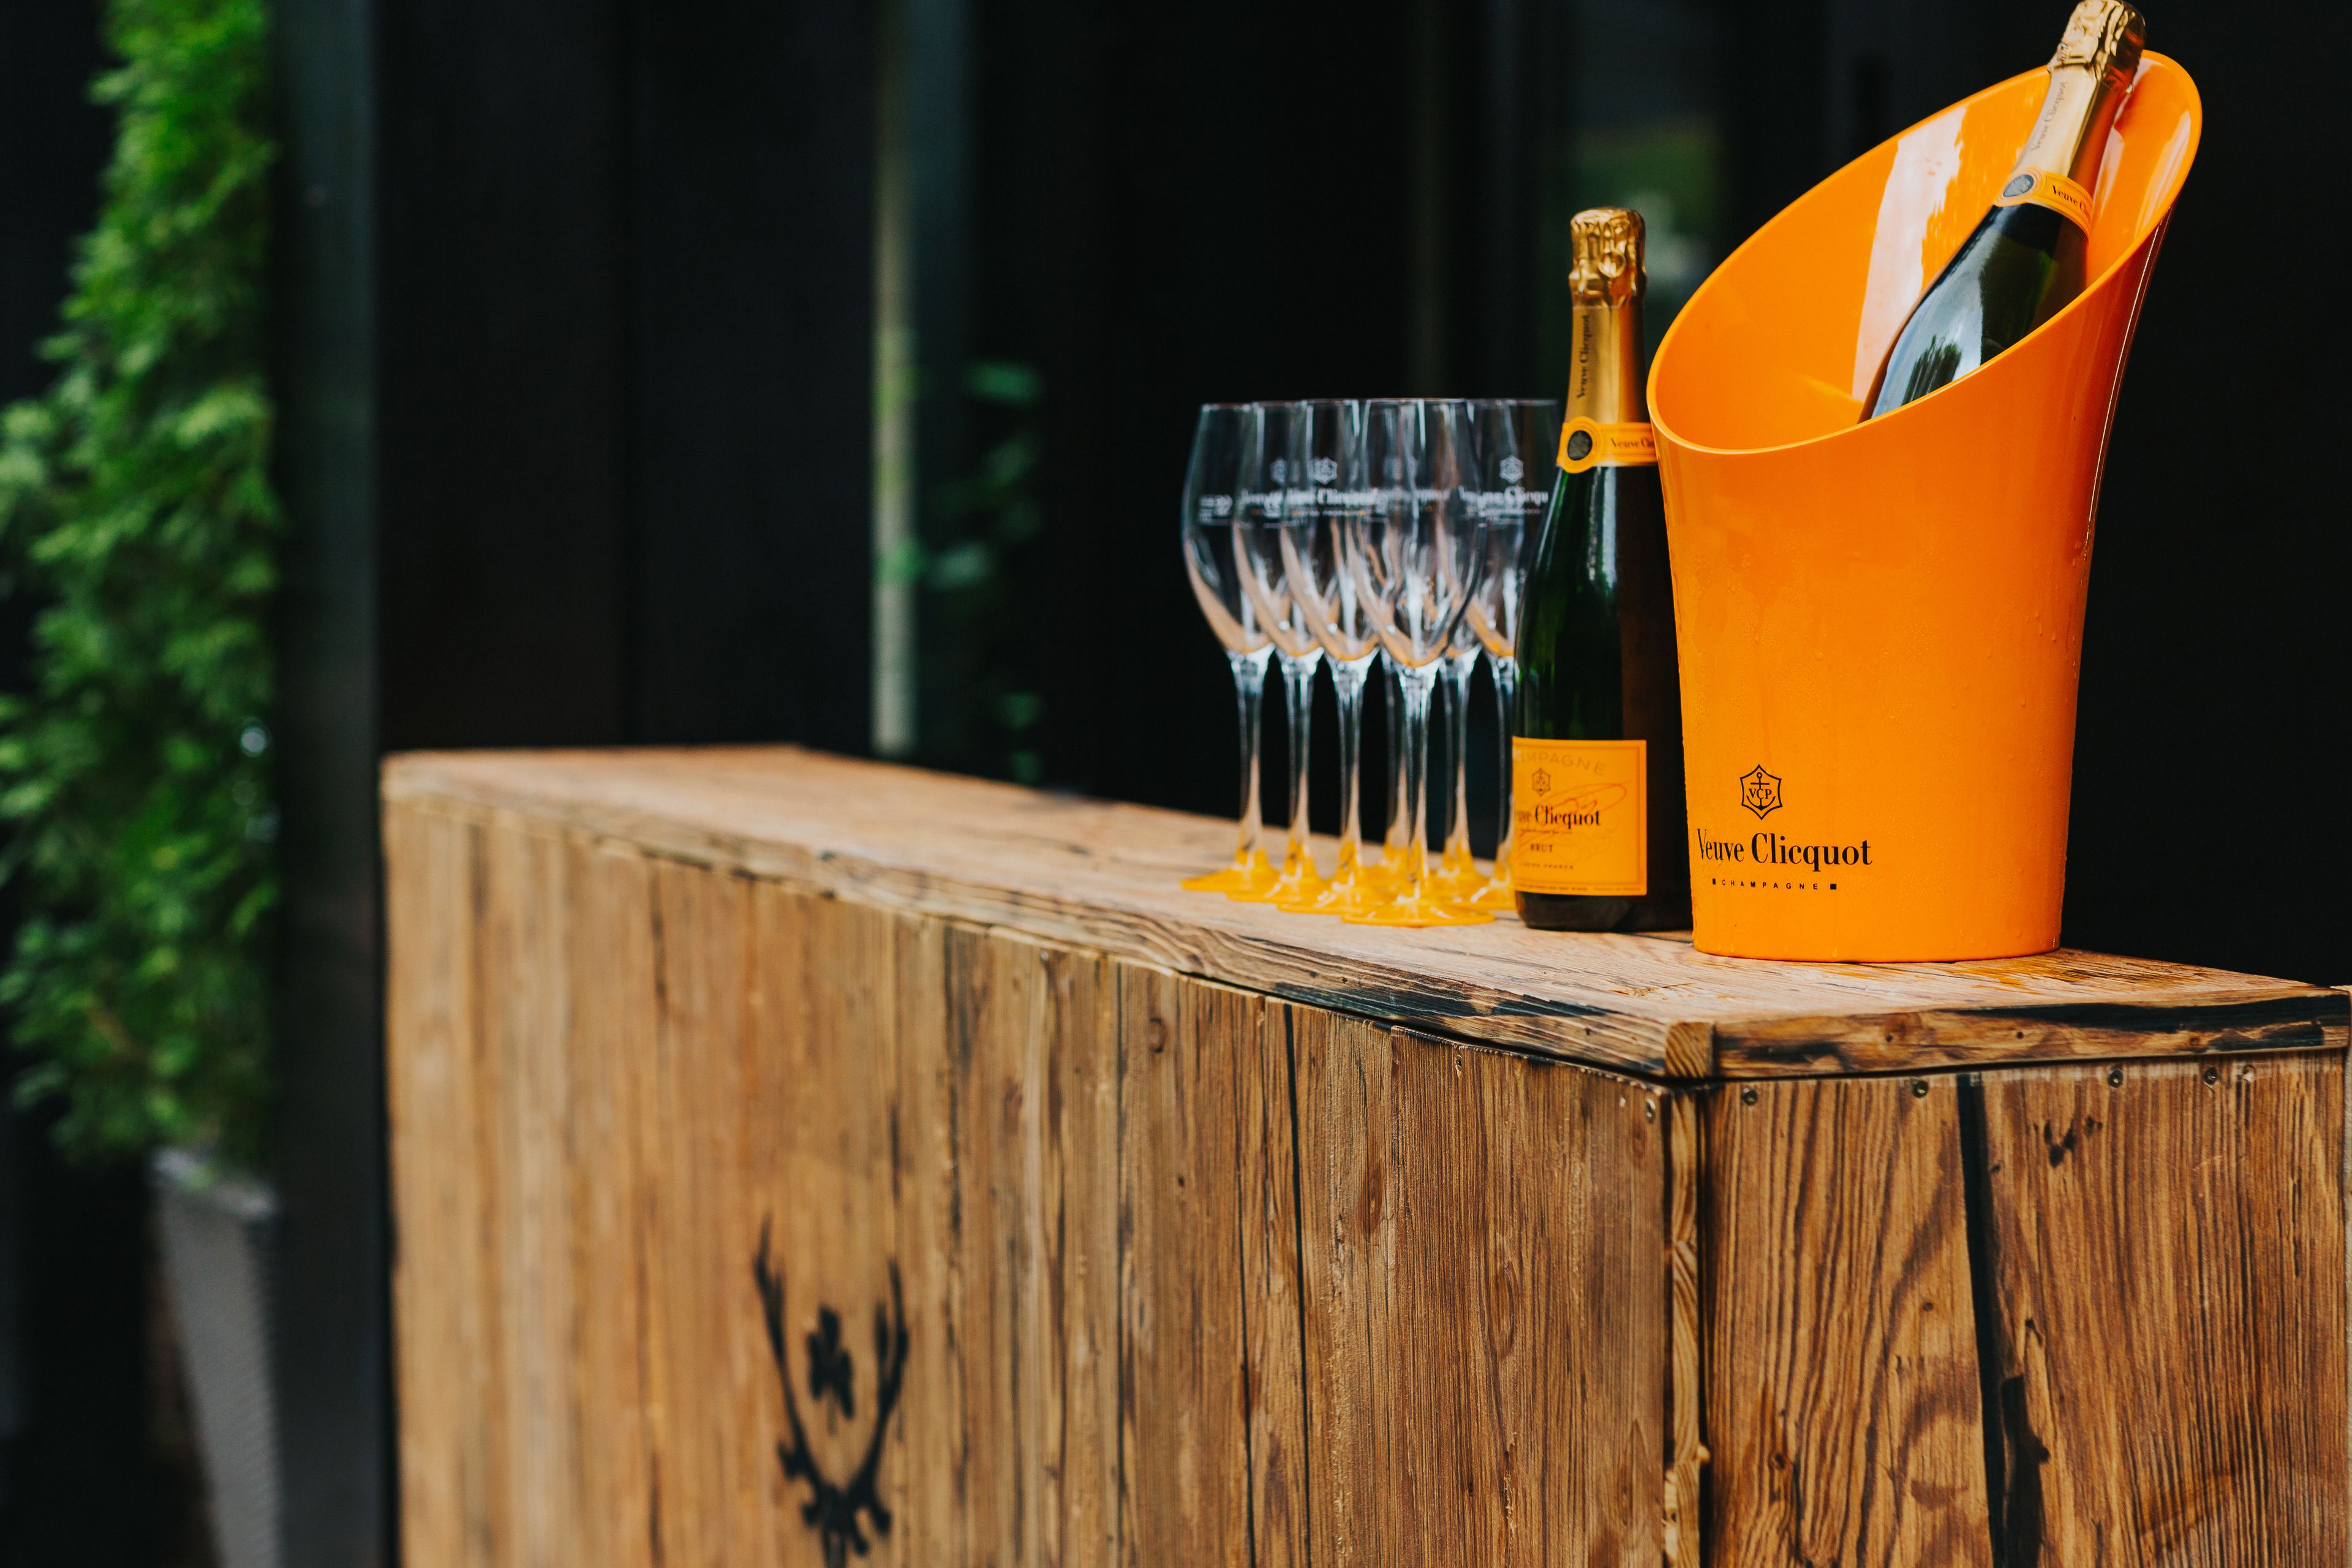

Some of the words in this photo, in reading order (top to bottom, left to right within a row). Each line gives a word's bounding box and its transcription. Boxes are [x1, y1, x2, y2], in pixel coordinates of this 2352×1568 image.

[2052, 184, 2078, 206] Veuve
[1610, 437, 1639, 448] Veuve
[1748, 788, 1772, 799] VCP
[1535, 804, 1600, 829] Clicquot
[1697, 828, 1745, 862] Veuve
[1751, 832, 1873, 872] Clicquot
[1722, 879, 1818, 890] CHAMPAGNE
